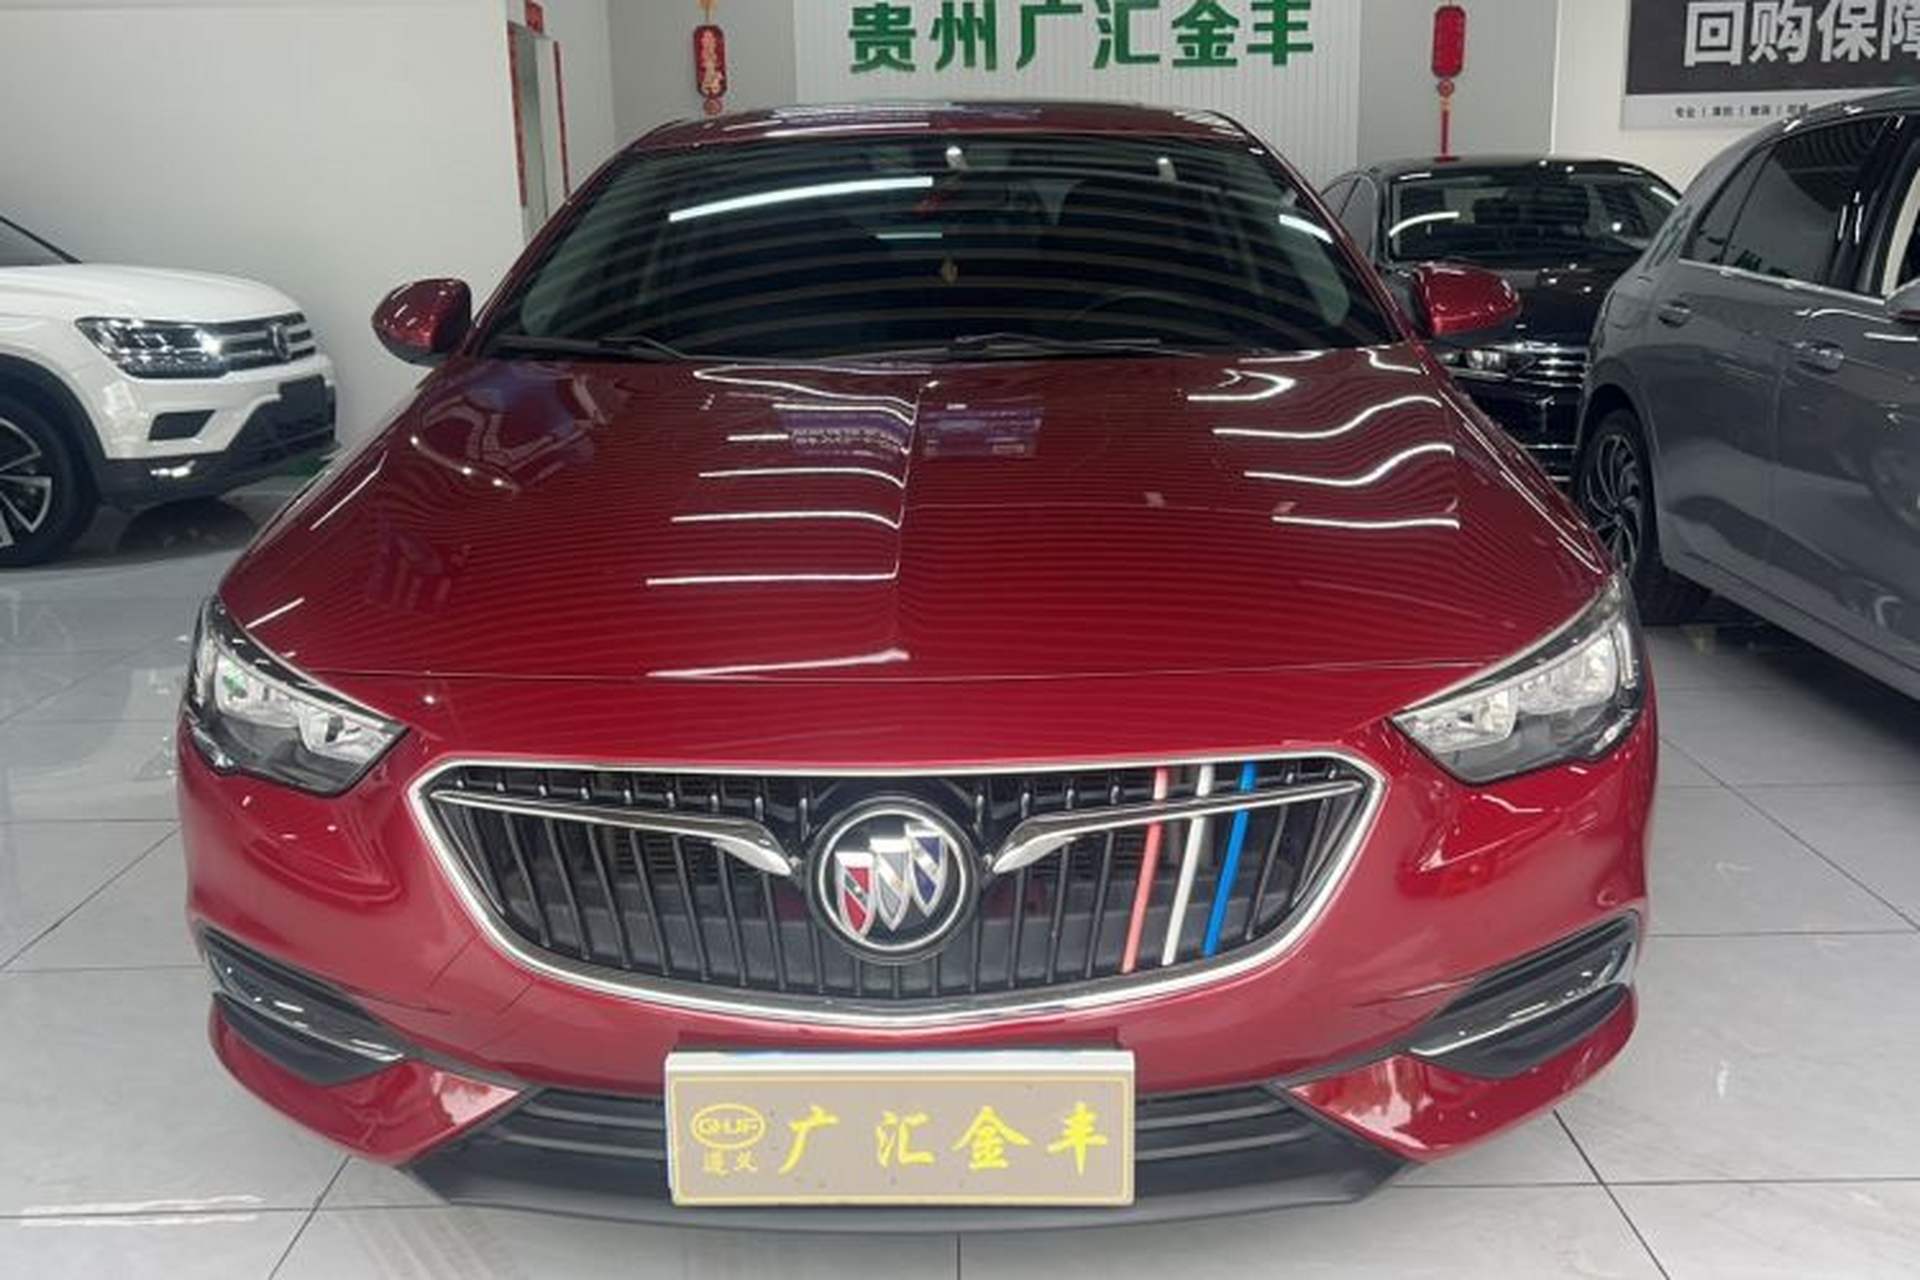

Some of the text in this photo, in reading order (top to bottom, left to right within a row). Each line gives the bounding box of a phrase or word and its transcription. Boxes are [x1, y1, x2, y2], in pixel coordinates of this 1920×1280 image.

[848, 0, 1314, 73] 贵州广汇金丰
[778, 1101, 1109, 1175] 广汇金丰
